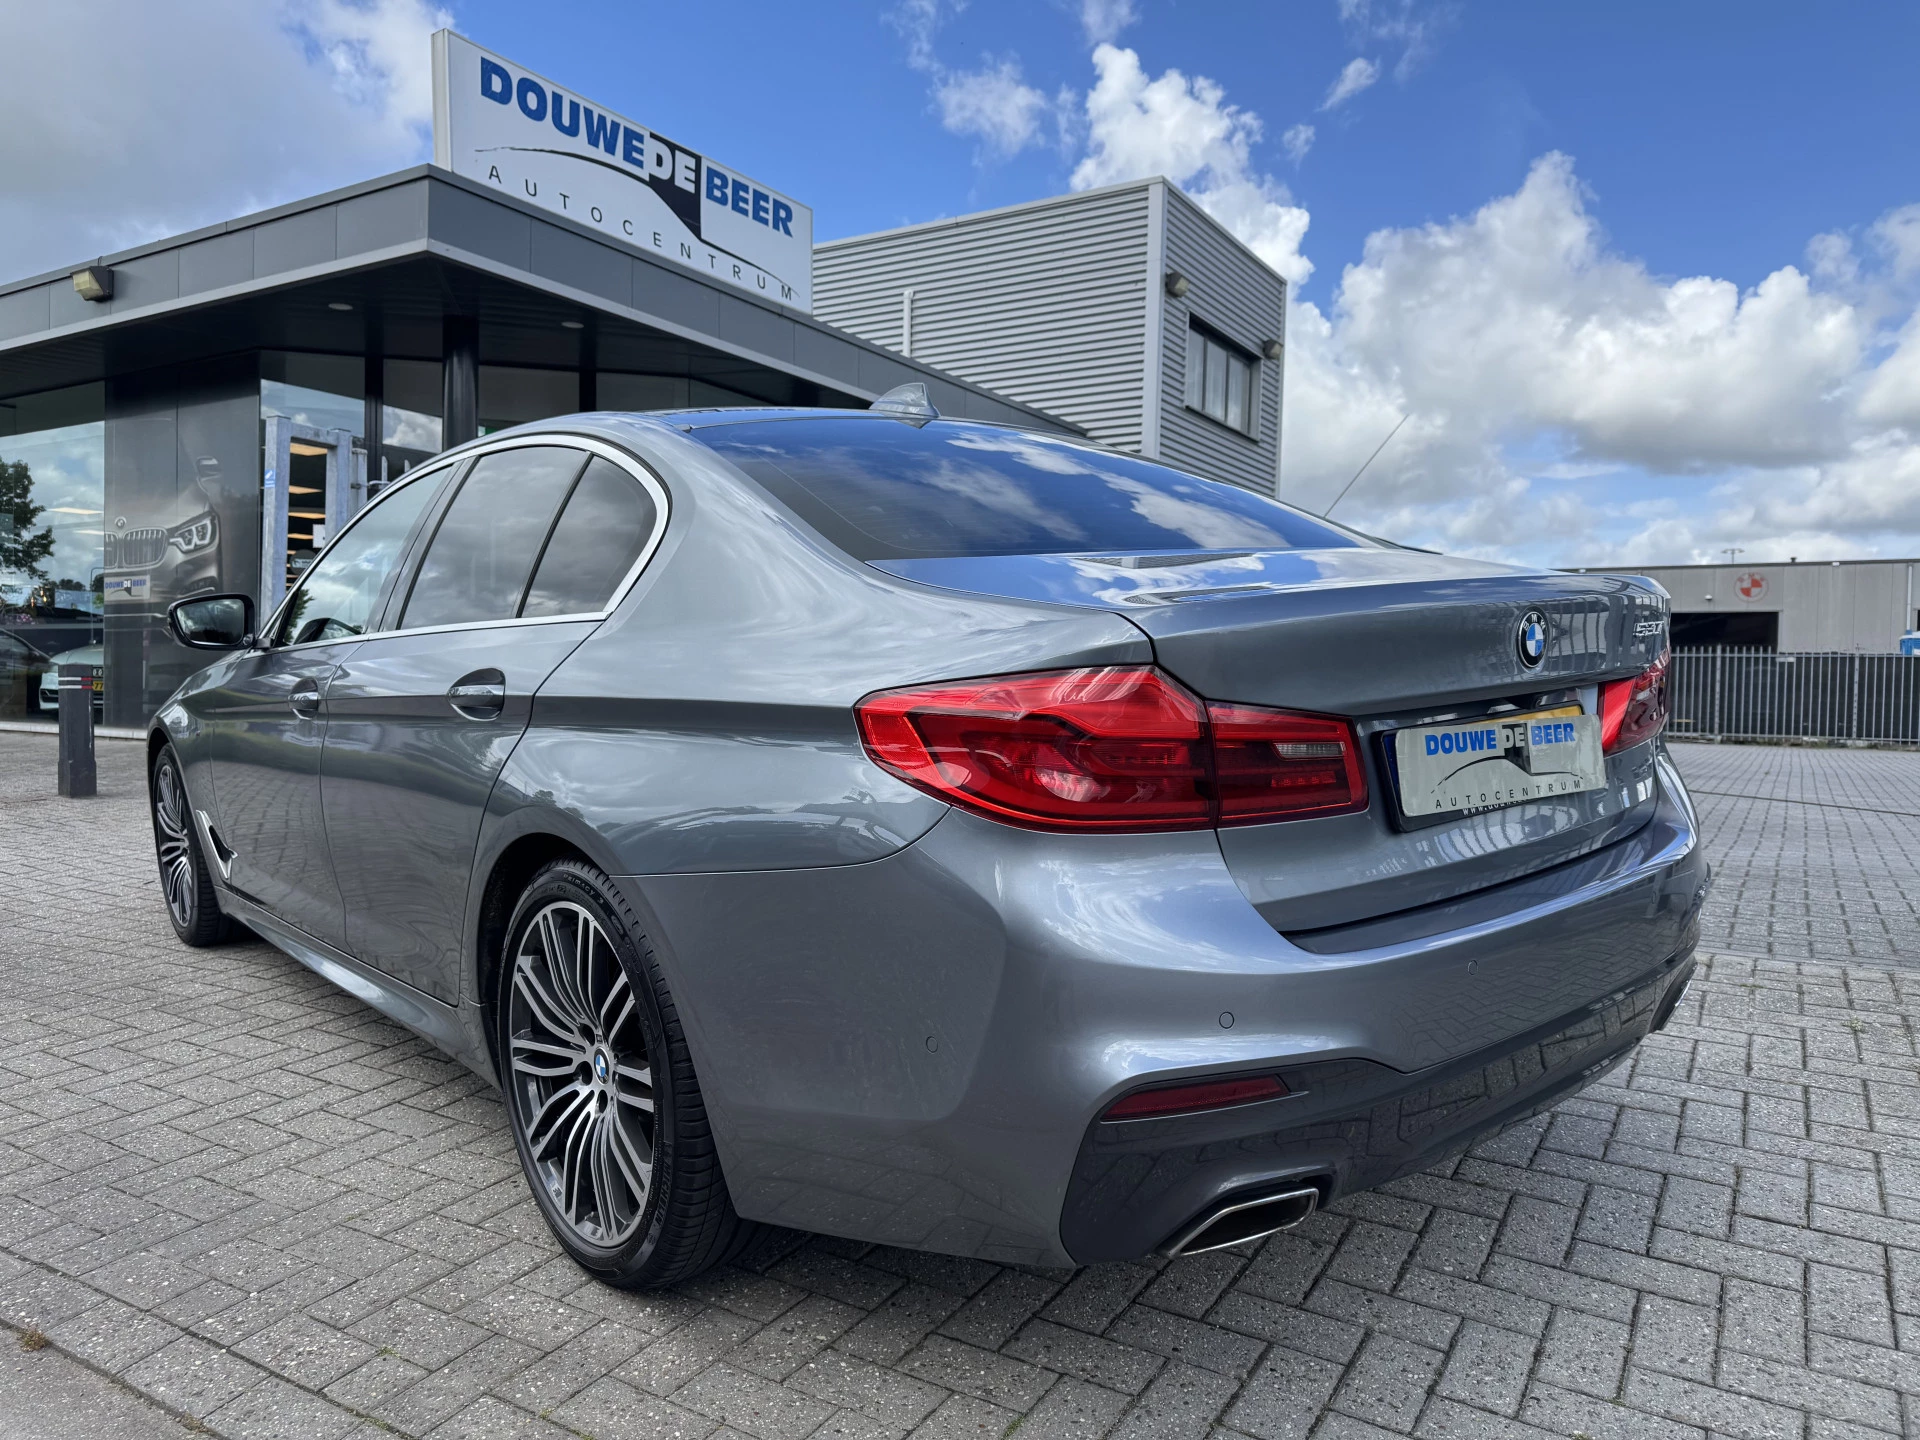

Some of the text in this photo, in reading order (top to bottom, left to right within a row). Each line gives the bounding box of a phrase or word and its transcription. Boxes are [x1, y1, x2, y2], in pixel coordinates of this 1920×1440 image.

[481, 56, 794, 238] DOUWE DE BEER
[488, 165, 793, 301] AUTOCENTRUM
[1425, 723, 1576, 756] DOUWE DE BEER
[1435, 779, 1582, 809] AUTOCENTRUM
